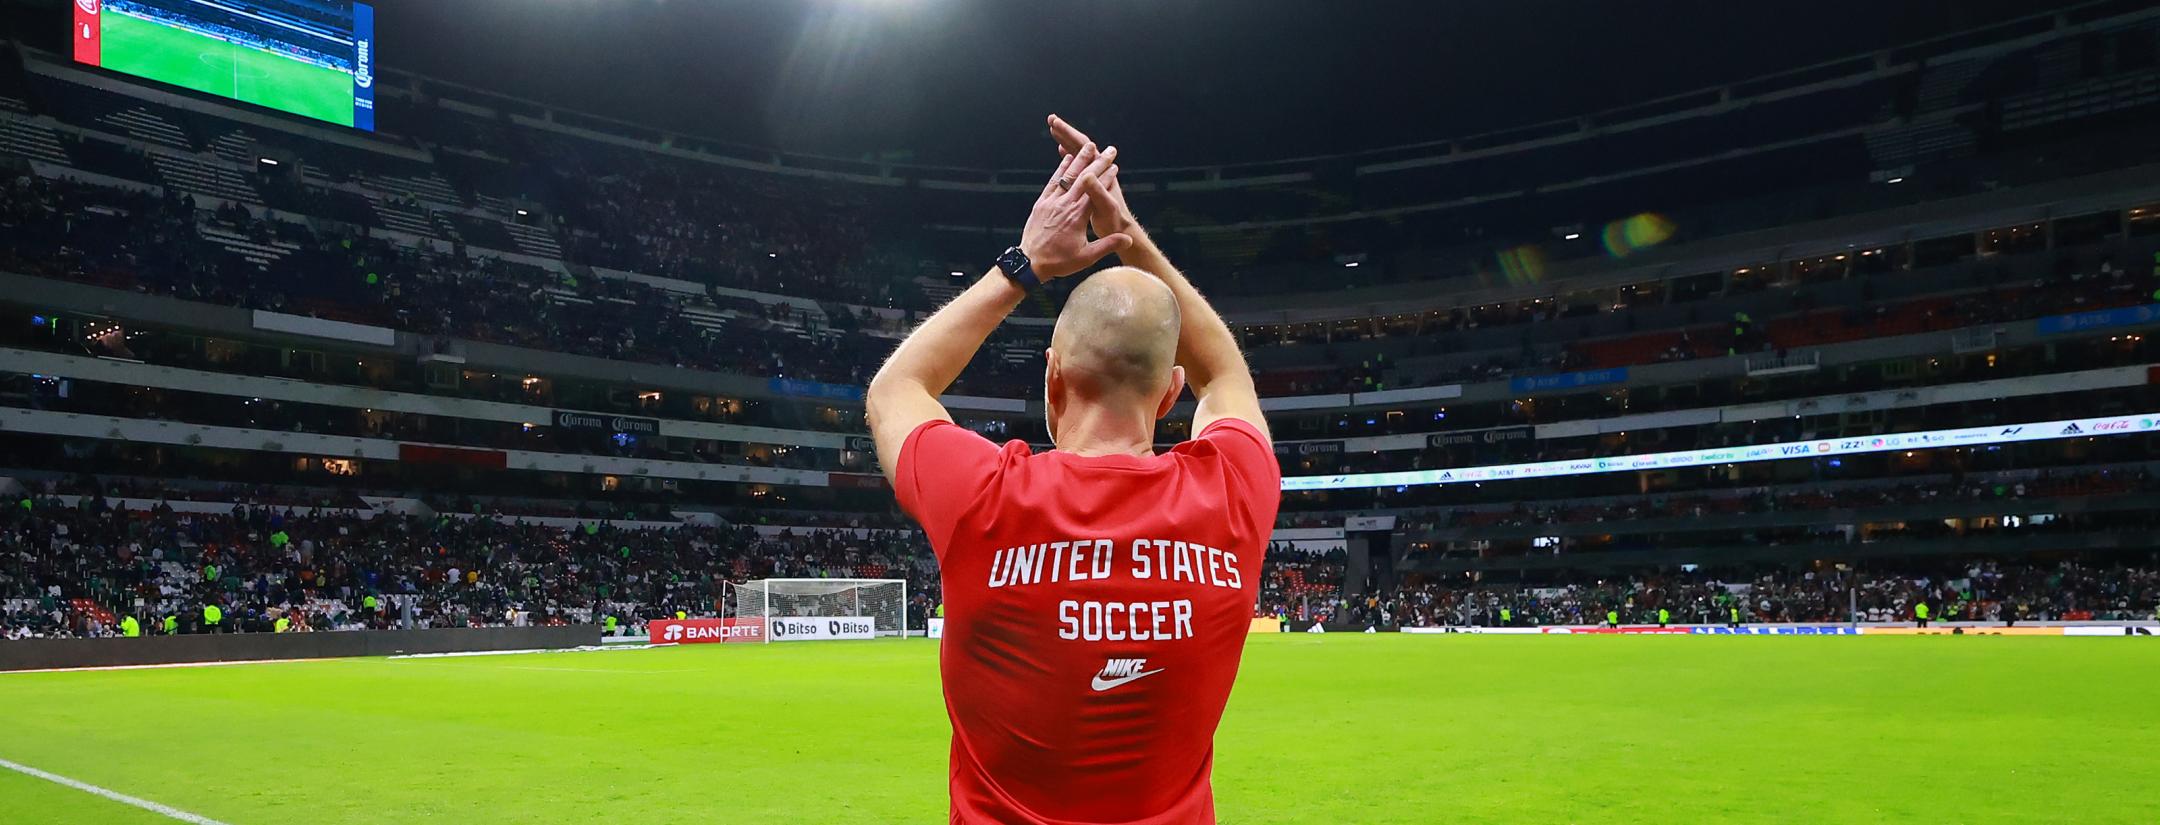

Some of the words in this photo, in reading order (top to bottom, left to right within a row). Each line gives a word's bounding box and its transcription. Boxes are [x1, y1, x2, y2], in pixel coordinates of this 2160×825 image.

[354, 40, 373, 88] Corona
[560, 413, 602, 428] Corona
[611, 417, 653, 432] Corona
[1432, 435, 1473, 447] Corona
[1483, 431, 1527, 443] Corona
[1298, 443, 1338, 455] Corona
[1781, 444, 1810, 455] VISA
[988, 538, 1114, 588] UNITED
[1131, 538, 1242, 589] STATES
[1058, 599, 1194, 641] SOCCER
[686, 625, 760, 639] BANORTE
[788, 623, 817, 635] Bitso
[843, 622, 870, 634] Bitso
[1102, 658, 1147, 678] NIKE
